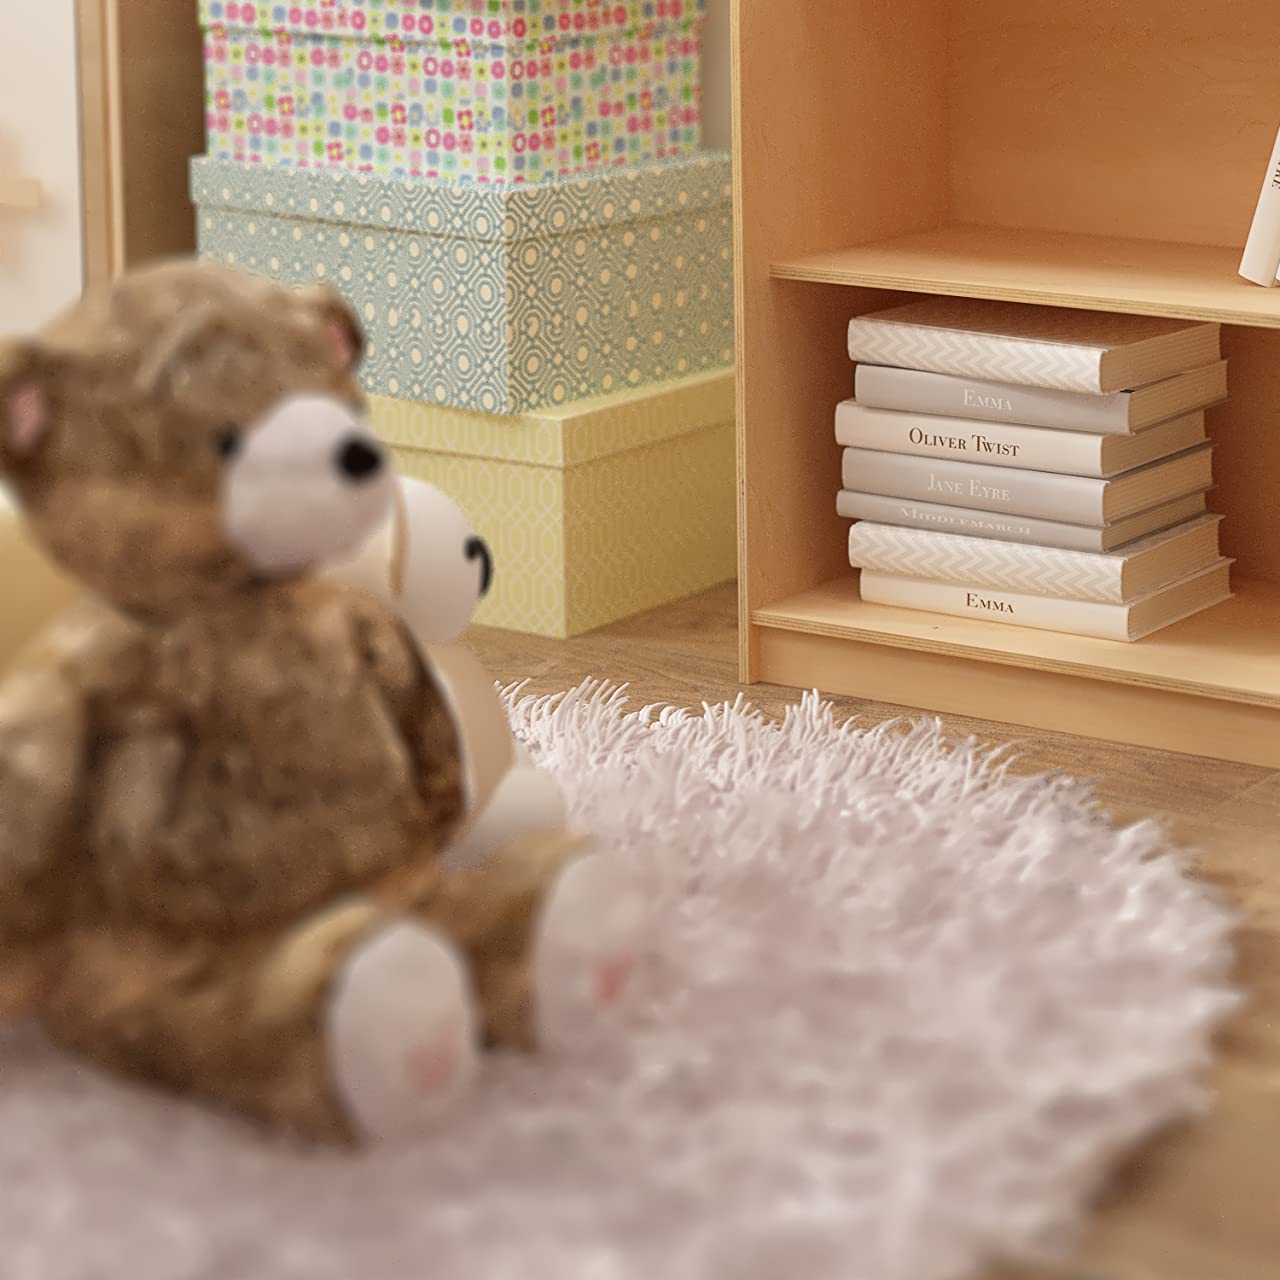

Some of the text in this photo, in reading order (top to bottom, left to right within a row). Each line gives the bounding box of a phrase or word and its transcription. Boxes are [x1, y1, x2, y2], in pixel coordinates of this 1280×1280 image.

[962, 388, 1013, 412] EMMA
[908, 426, 1020, 458] OLIVER TWIST
[927, 472, 1011, 502] JANE EYRE
[965, 591, 1015, 615] EMMA
